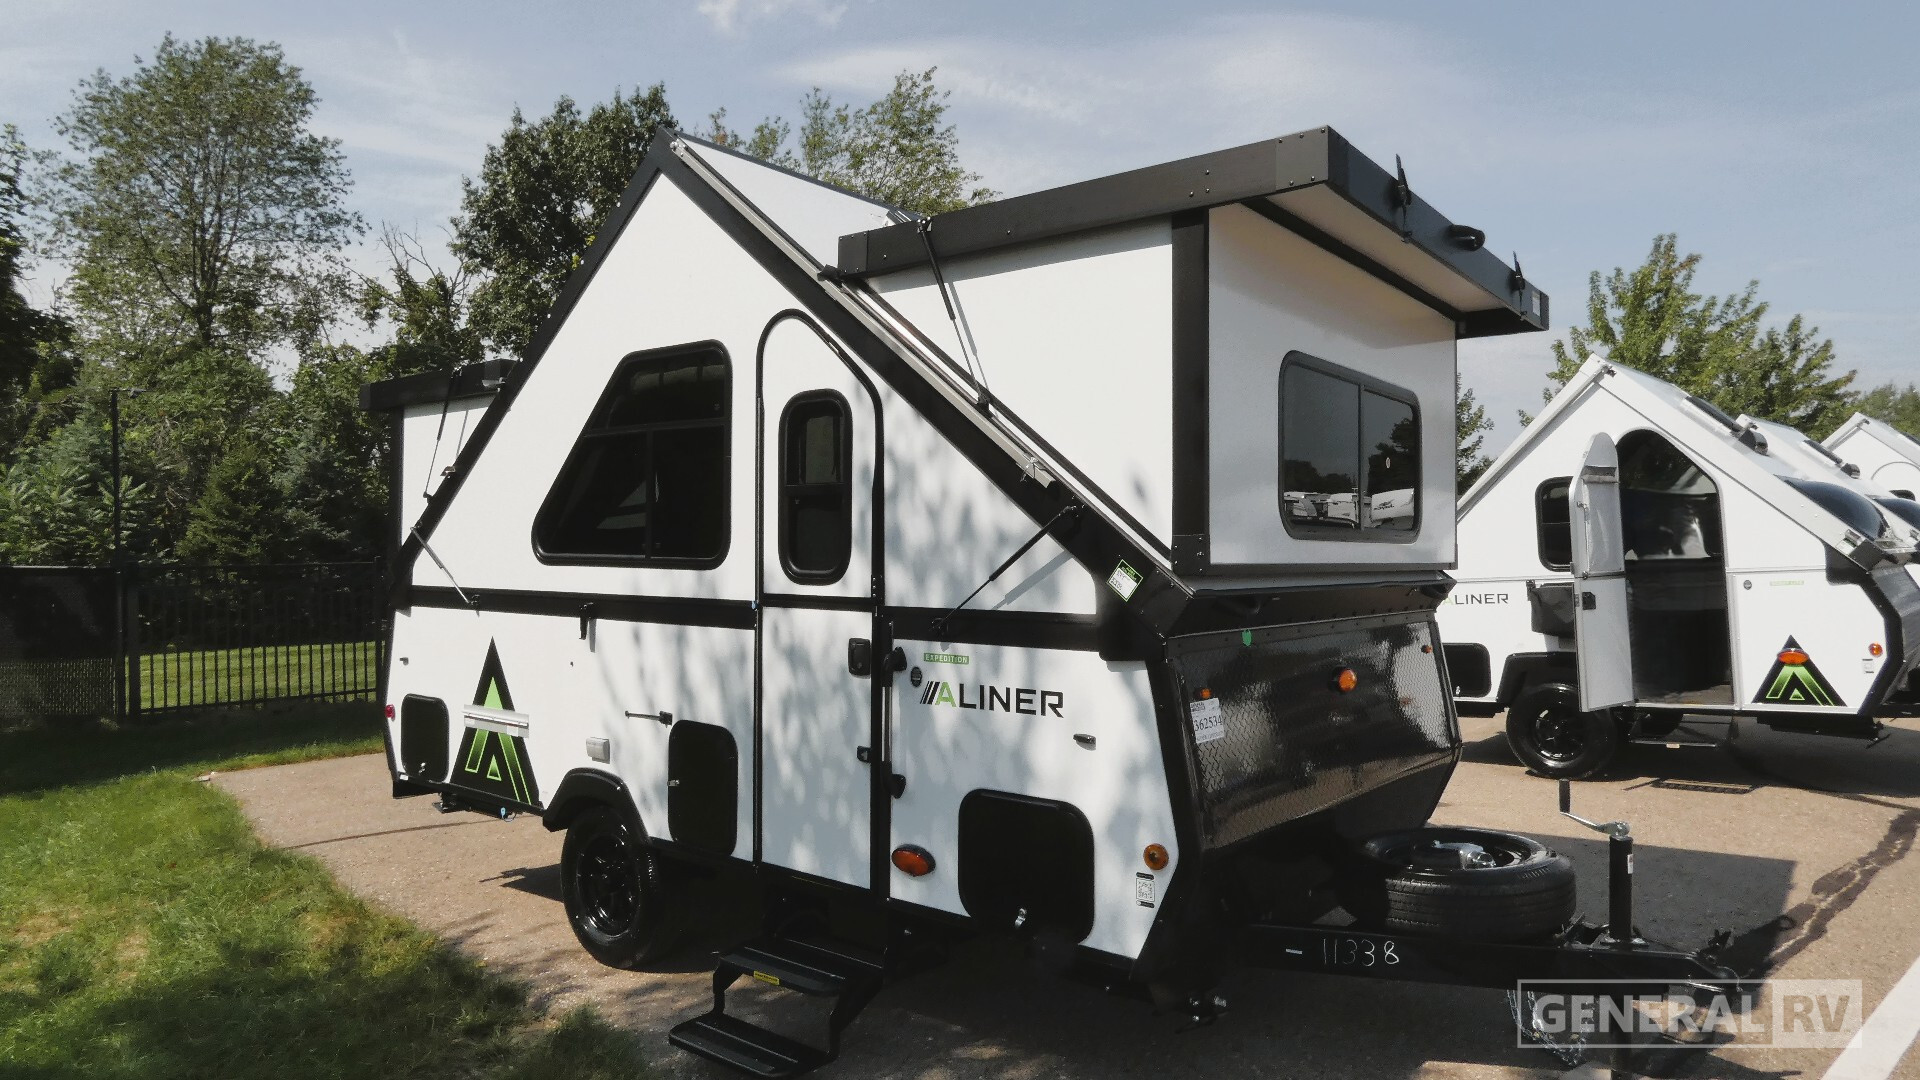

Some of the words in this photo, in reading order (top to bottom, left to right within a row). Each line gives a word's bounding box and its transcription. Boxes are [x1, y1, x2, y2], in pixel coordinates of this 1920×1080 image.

[924, 654, 969, 664] EXPEDITION
[934, 681, 1064, 718] ALINER
[1194, 715, 1223, 732] 362534
[1323, 938, 1400, 967] 11338
